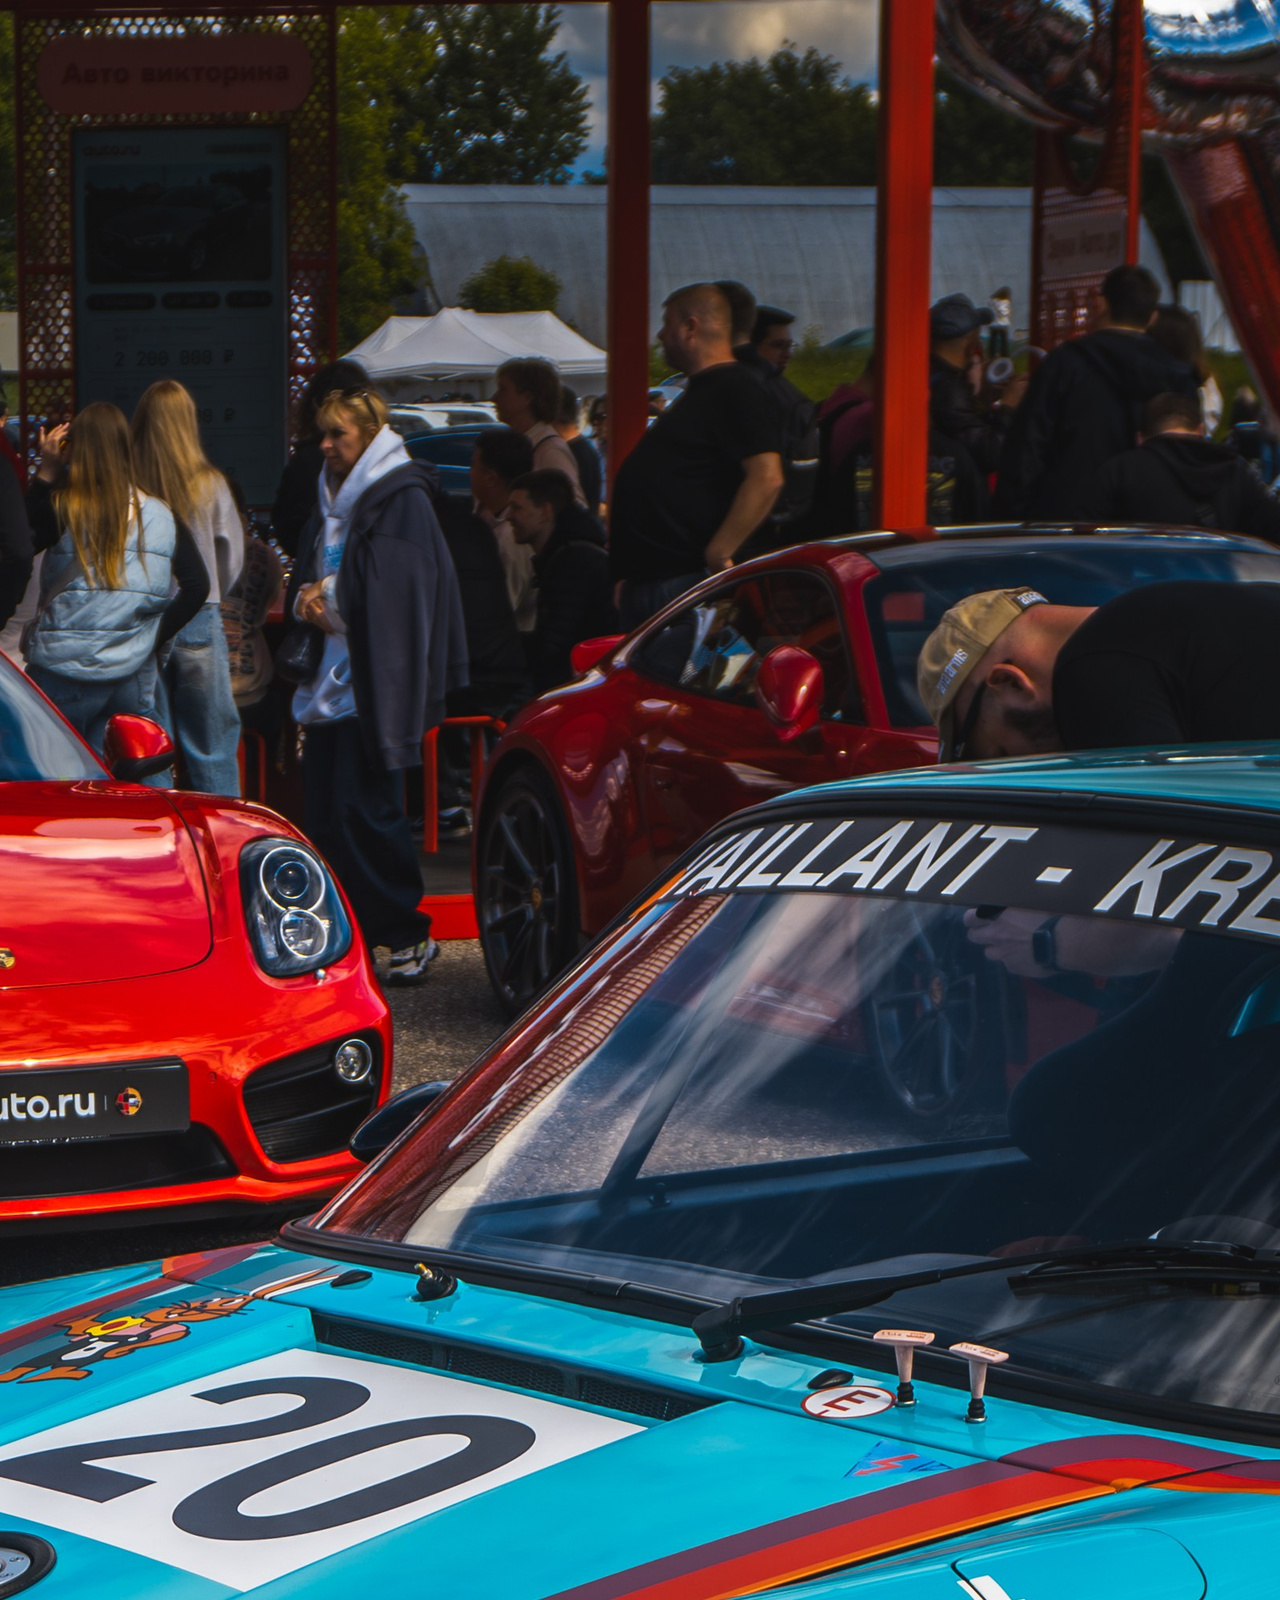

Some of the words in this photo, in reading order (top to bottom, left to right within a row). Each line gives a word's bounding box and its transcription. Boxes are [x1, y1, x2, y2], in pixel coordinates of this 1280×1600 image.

[62, 62, 130, 84] Авто
[141, 63, 290, 86] викторина
[657, 820, 1039, 901] VAILLANT
[821, 1389, 881, 1412] E
